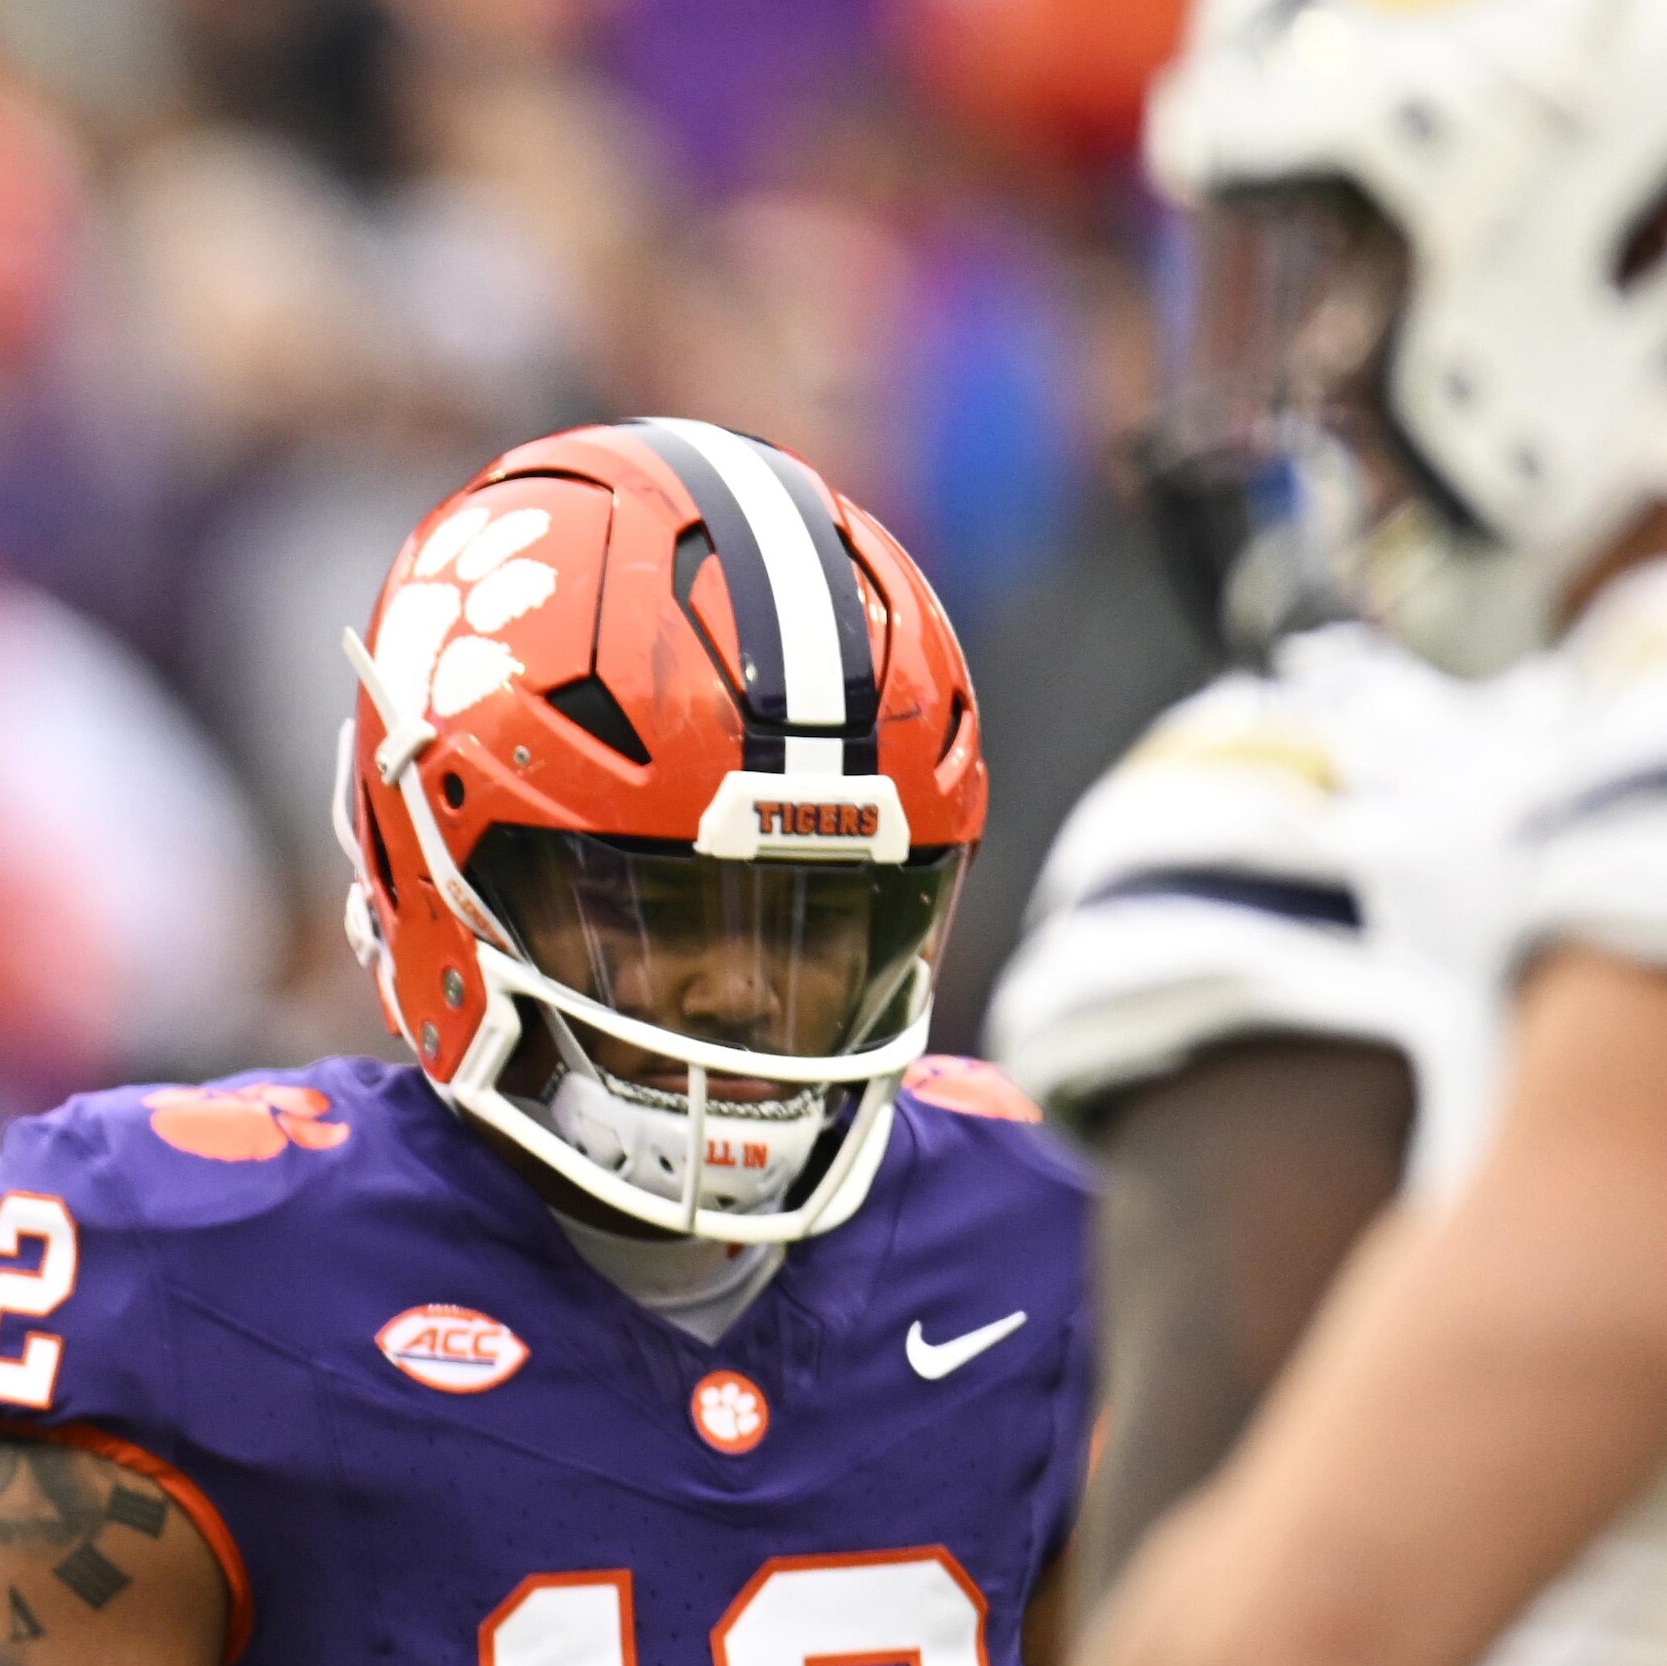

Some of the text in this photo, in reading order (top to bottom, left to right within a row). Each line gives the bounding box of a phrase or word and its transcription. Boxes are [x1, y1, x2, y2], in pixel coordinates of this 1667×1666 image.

[752, 799, 879, 837] TIGERS
[682, 1137, 769, 1170] LL IN
[402, 1327, 503, 1358] ACC
